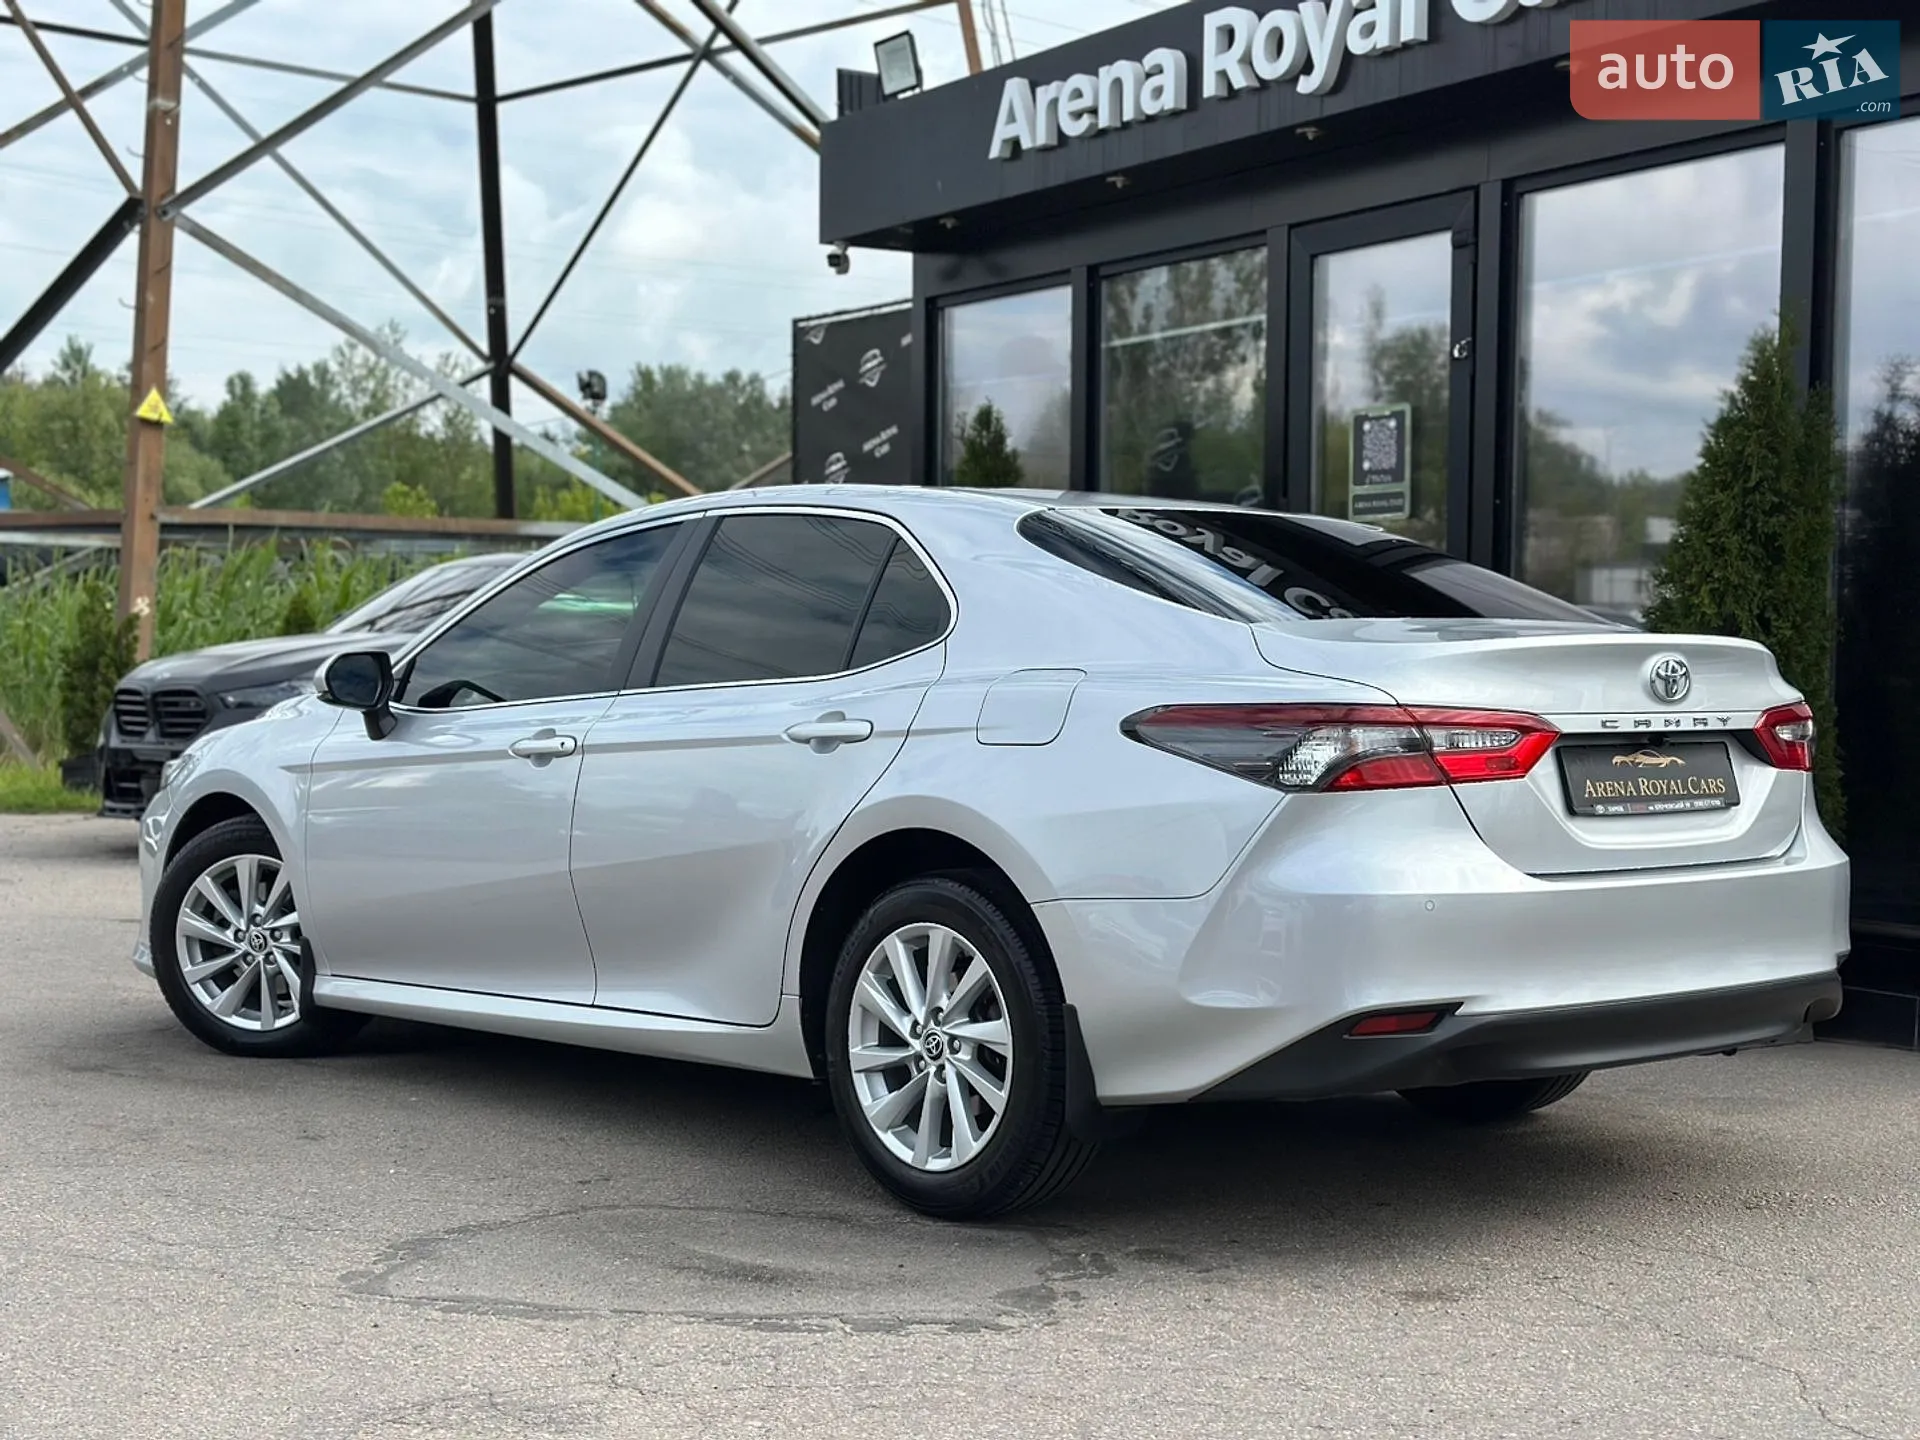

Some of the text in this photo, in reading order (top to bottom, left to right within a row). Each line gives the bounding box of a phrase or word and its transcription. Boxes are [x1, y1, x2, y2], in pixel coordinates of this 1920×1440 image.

[988, 47, 1188, 160] Arena
[1601, 715, 1732, 730] CAMRY
[1584, 775, 1726, 798] ARENA ROYAL CARS
